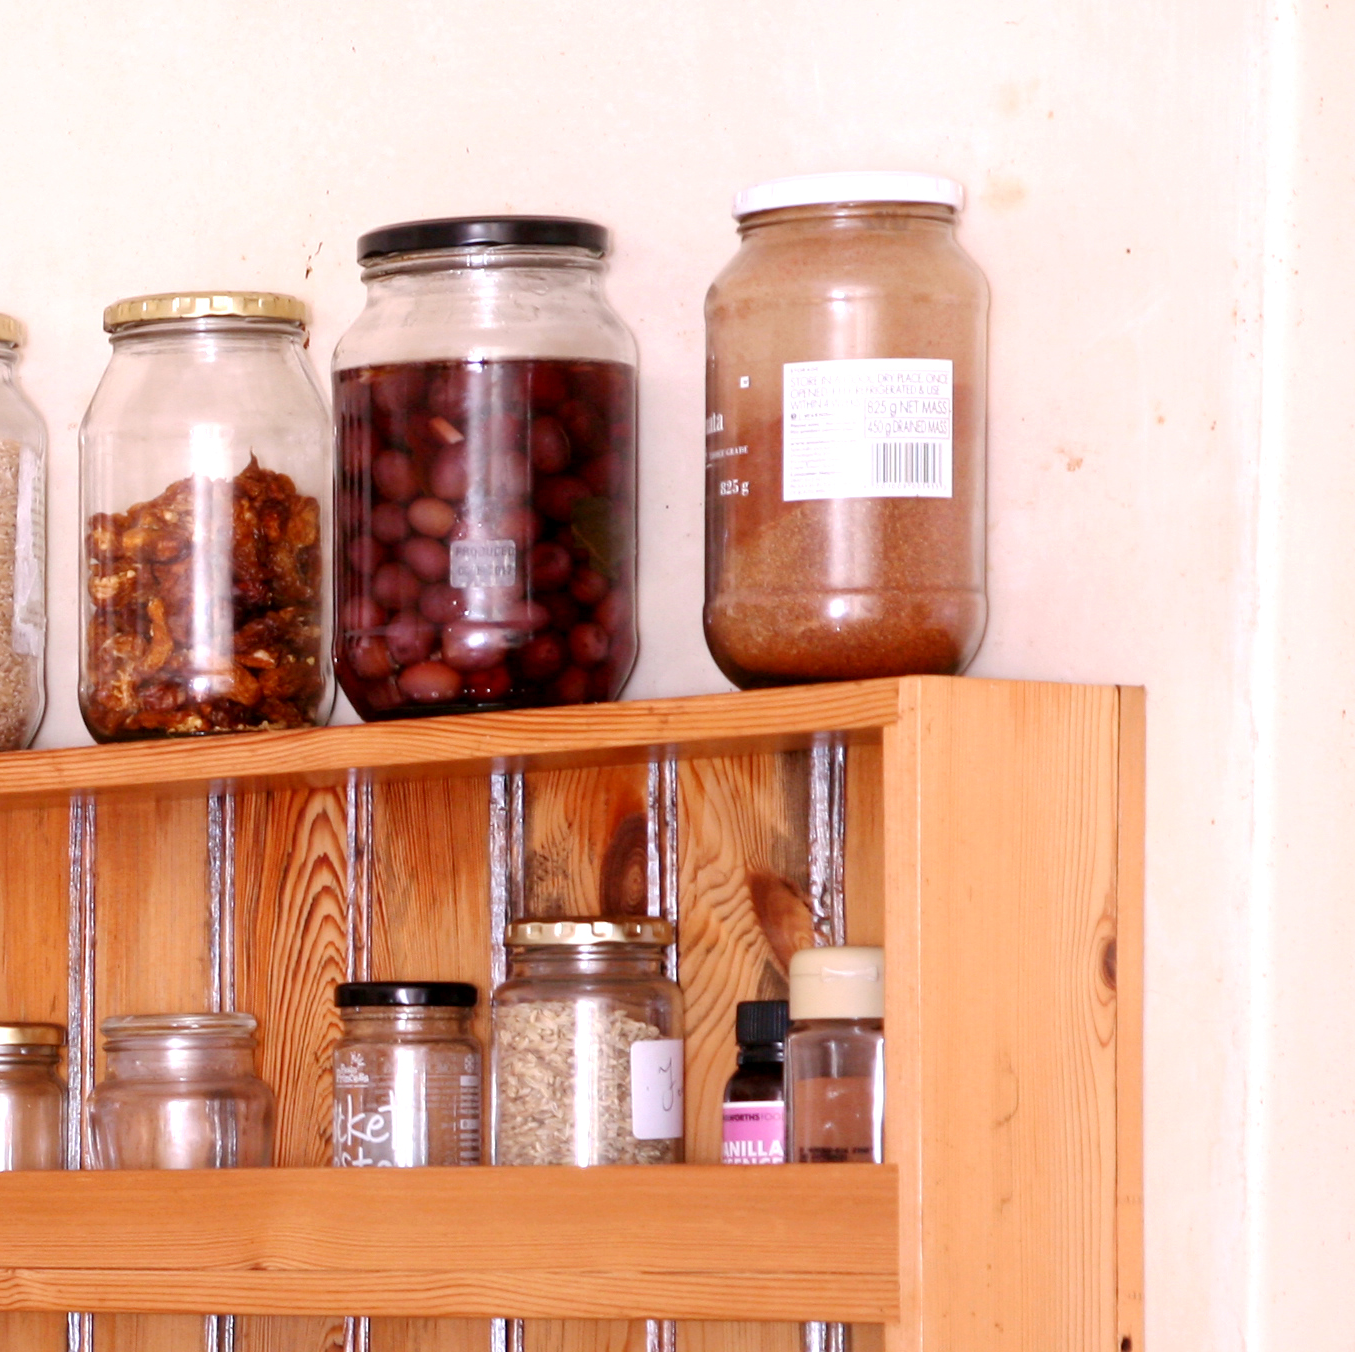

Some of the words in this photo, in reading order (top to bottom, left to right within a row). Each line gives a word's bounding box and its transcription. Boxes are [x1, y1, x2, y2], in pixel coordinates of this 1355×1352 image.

[926, 385, 940, 396] USE
[867, 399, 887, 414] 825
[889, 402, 897, 418] g
[900, 400, 920, 414] NET
[922, 400, 948, 415] MASS
[867, 419, 884, 434] 450
[892, 419, 927, 434] DRAINED
[928, 420, 948, 436] MASS
[719, 479, 740, 496] 825
[741, 481, 750, 497] g
